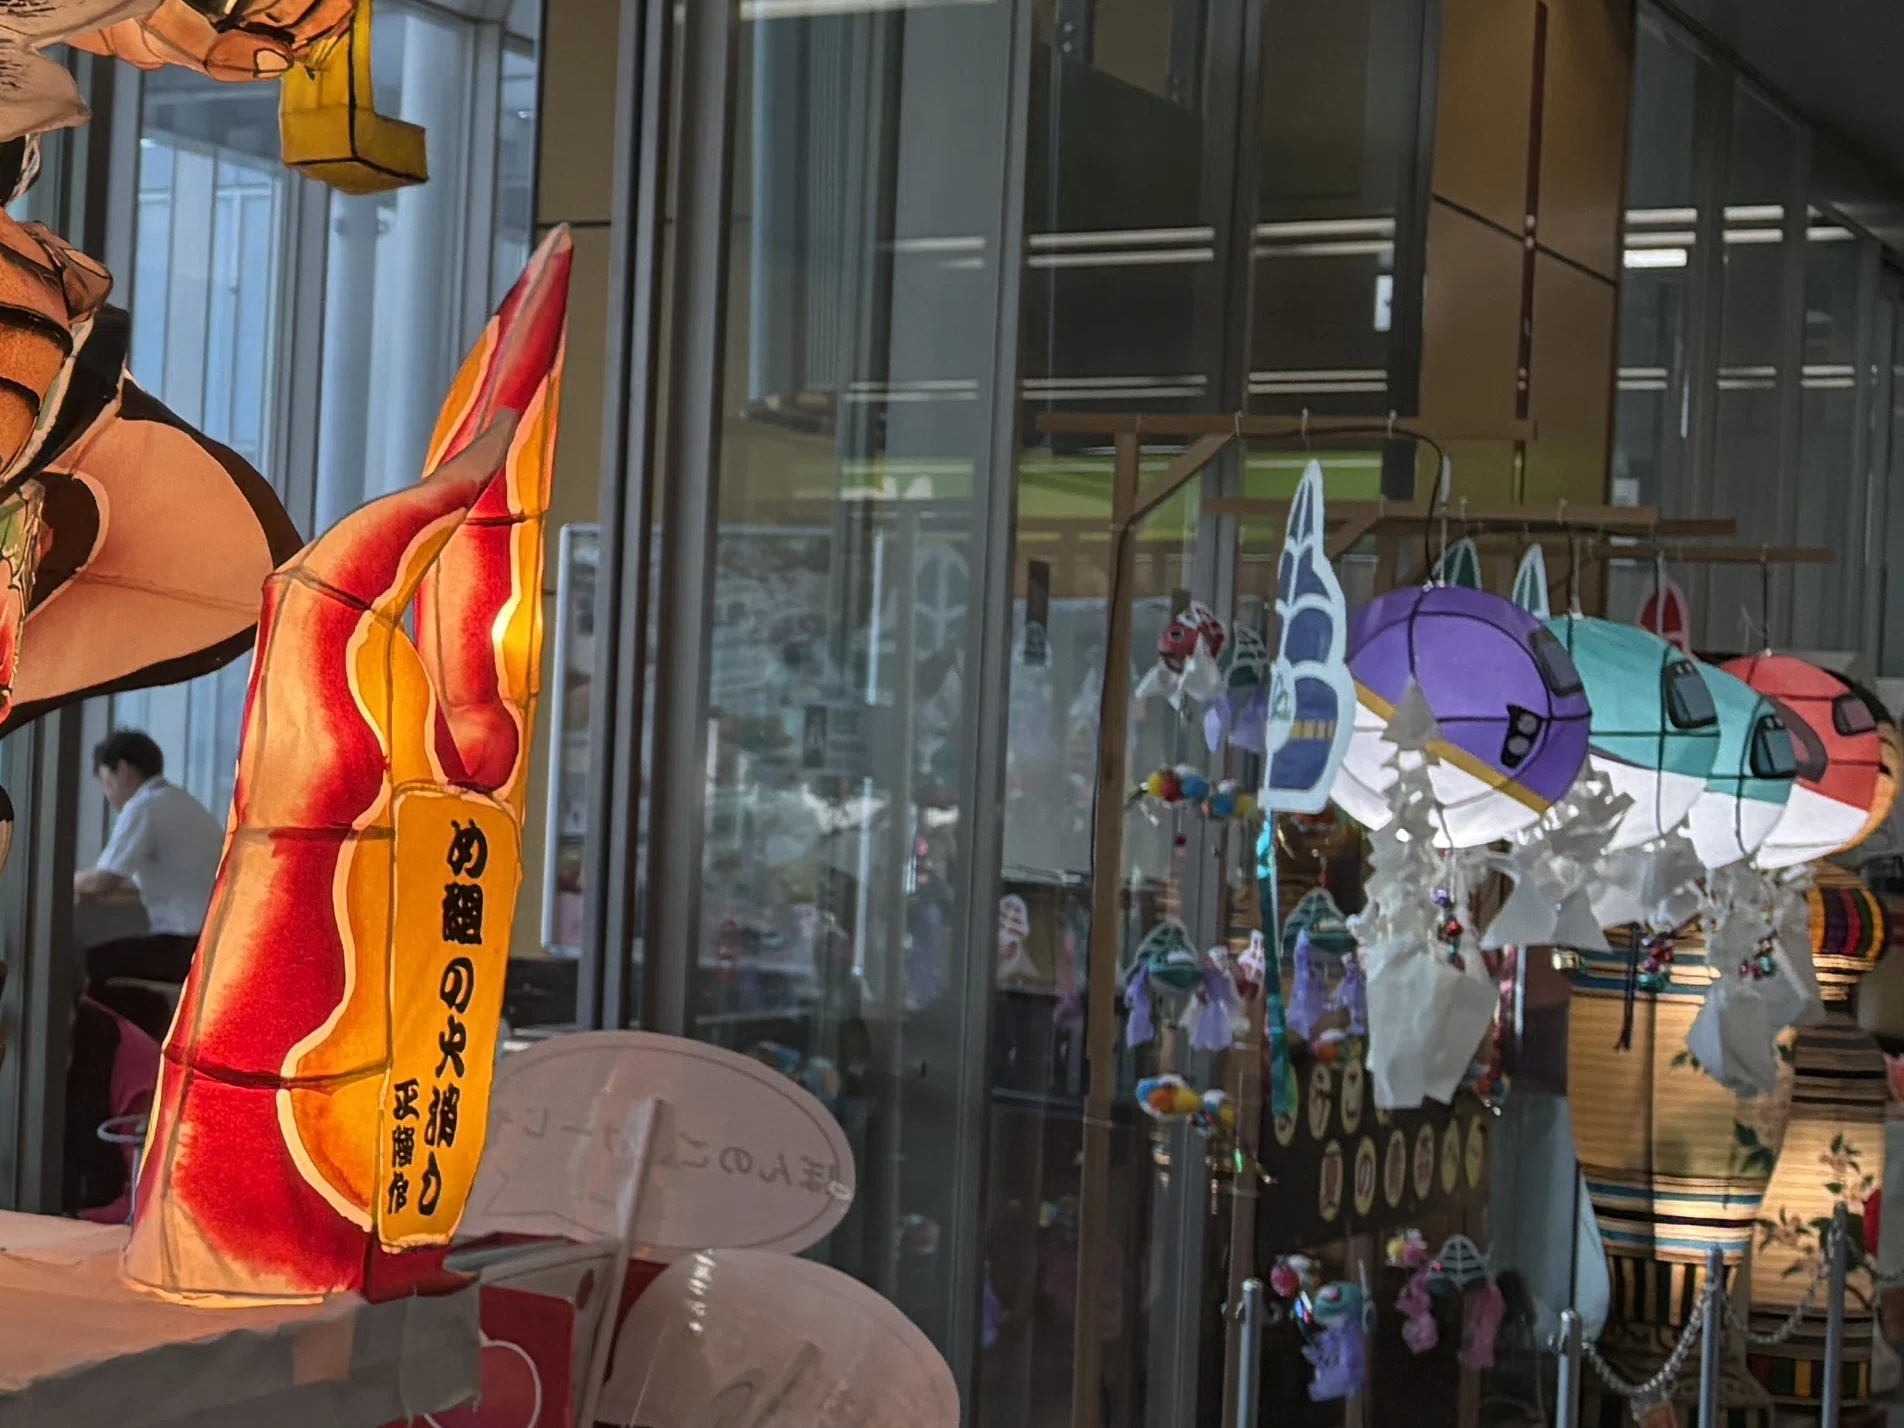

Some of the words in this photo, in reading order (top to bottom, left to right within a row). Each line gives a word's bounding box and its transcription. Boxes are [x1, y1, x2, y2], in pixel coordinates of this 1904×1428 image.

[418, 817, 489, 1217] め組の火消し
